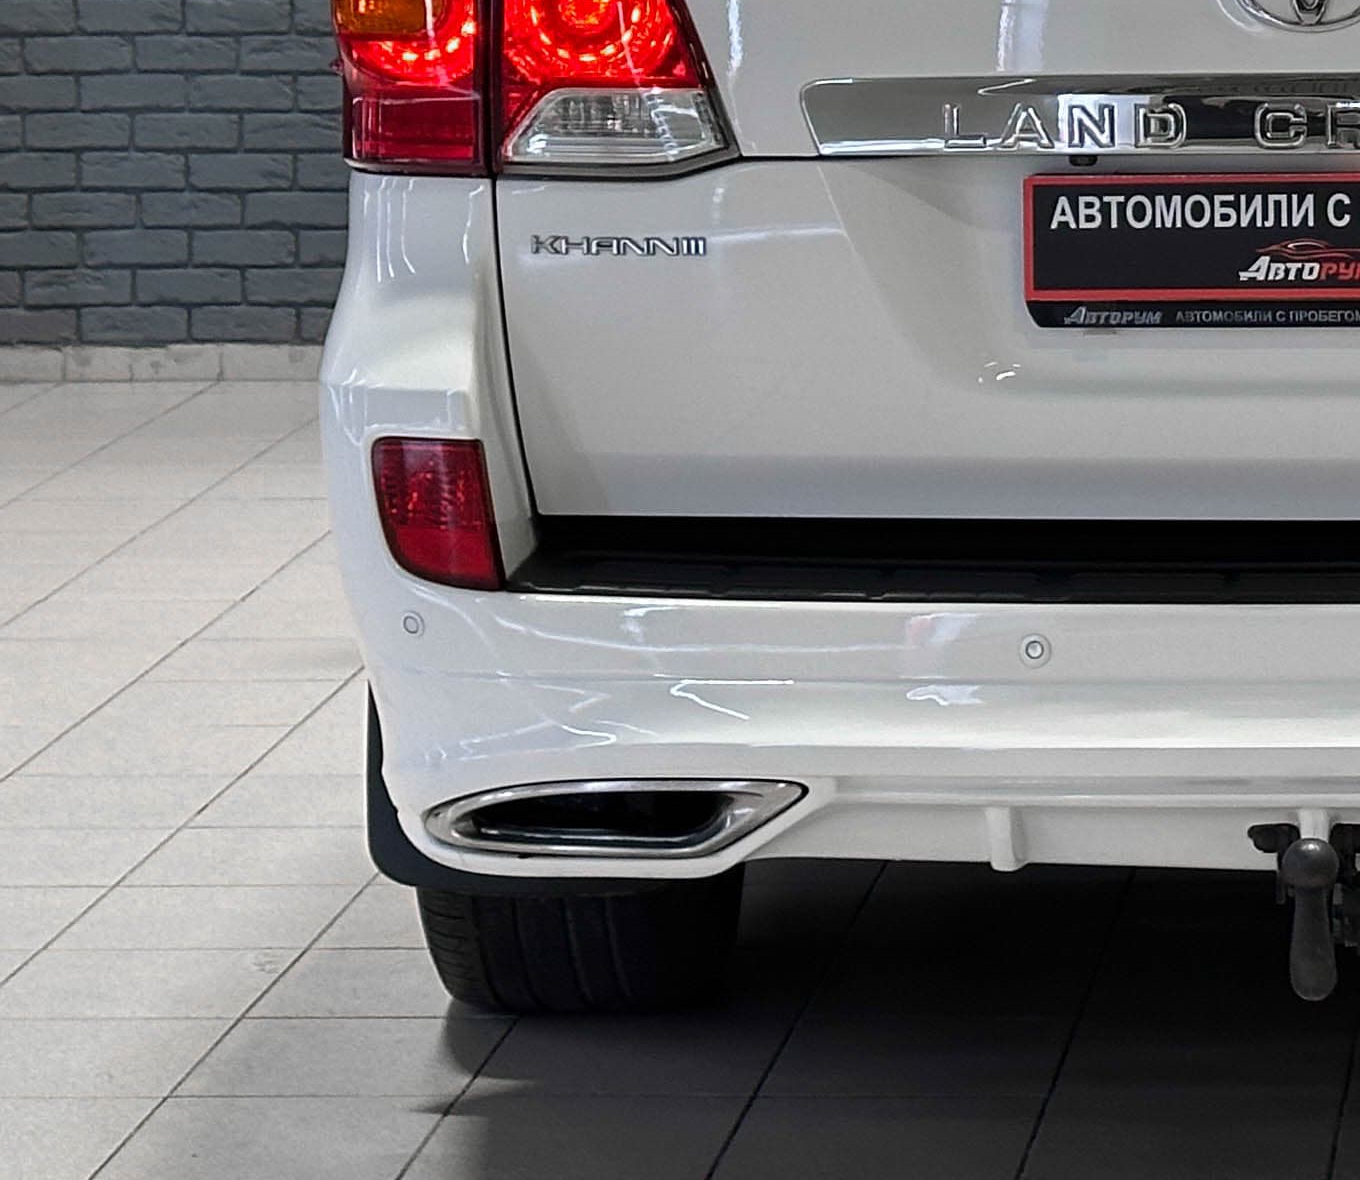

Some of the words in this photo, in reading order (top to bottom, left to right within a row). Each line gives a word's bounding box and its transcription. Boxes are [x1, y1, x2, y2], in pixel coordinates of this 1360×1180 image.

[943, 103, 1187, 149] LAND
[1051, 193, 1315, 230] АВТОМОБИЛИ
[1326, 192, 1350, 229] С
[1176, 310, 1272, 322] АВТОМОБИЛИ
